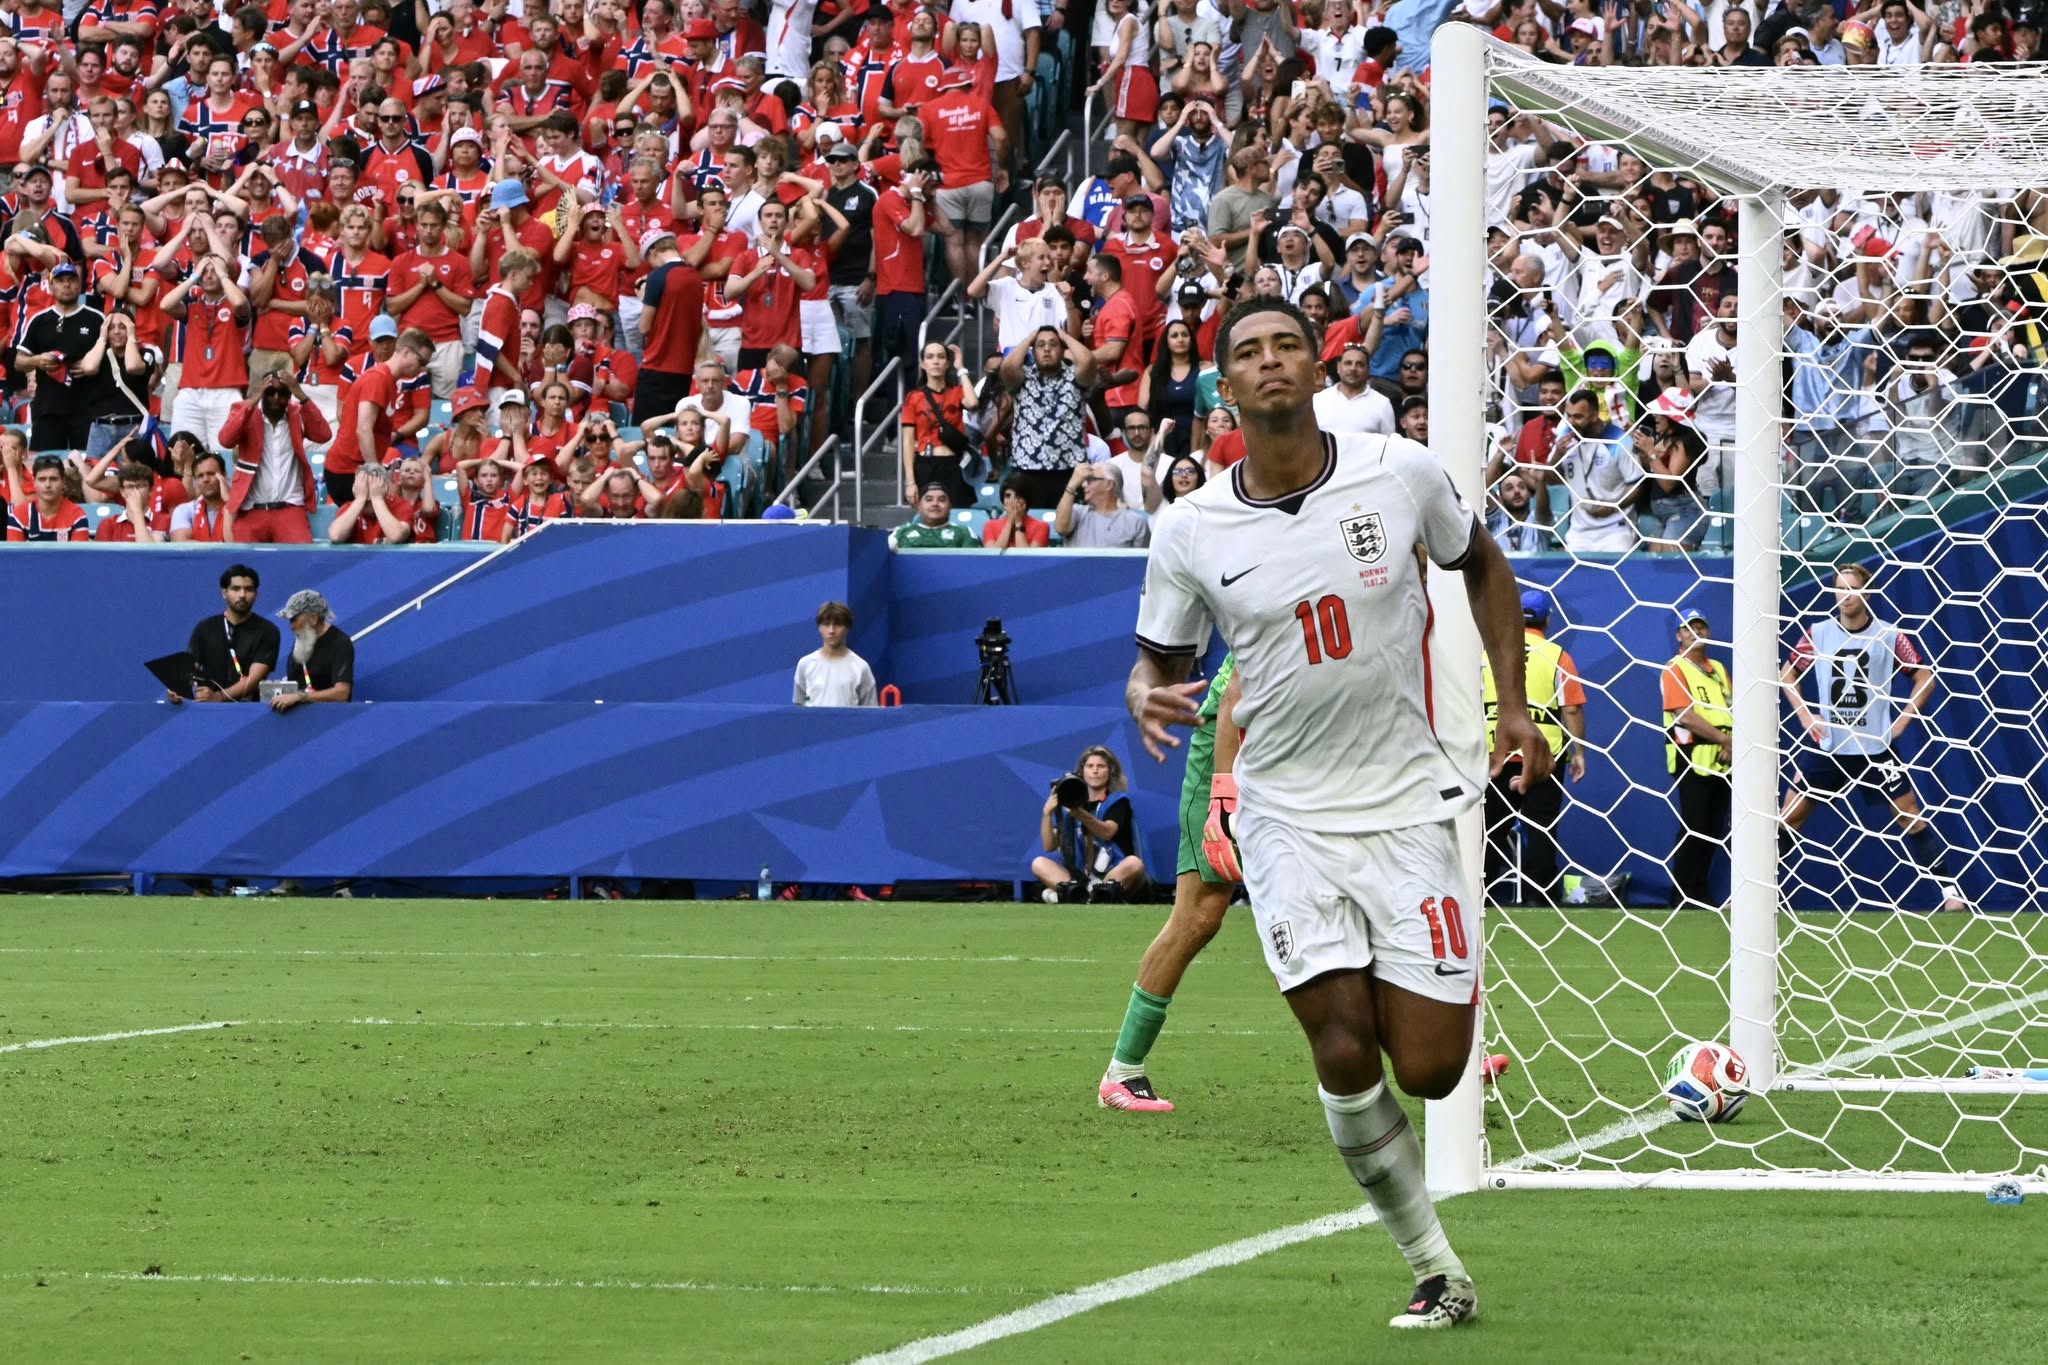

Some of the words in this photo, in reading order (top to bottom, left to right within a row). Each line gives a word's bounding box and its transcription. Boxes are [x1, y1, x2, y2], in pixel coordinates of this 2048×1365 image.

[1334, 57, 1342, 72] 7
[1567, 462, 1574, 479] 8
[1359, 566, 1389, 579] NORWAY
[1295, 594, 1353, 665] 10
[1420, 896, 1468, 959] 10
